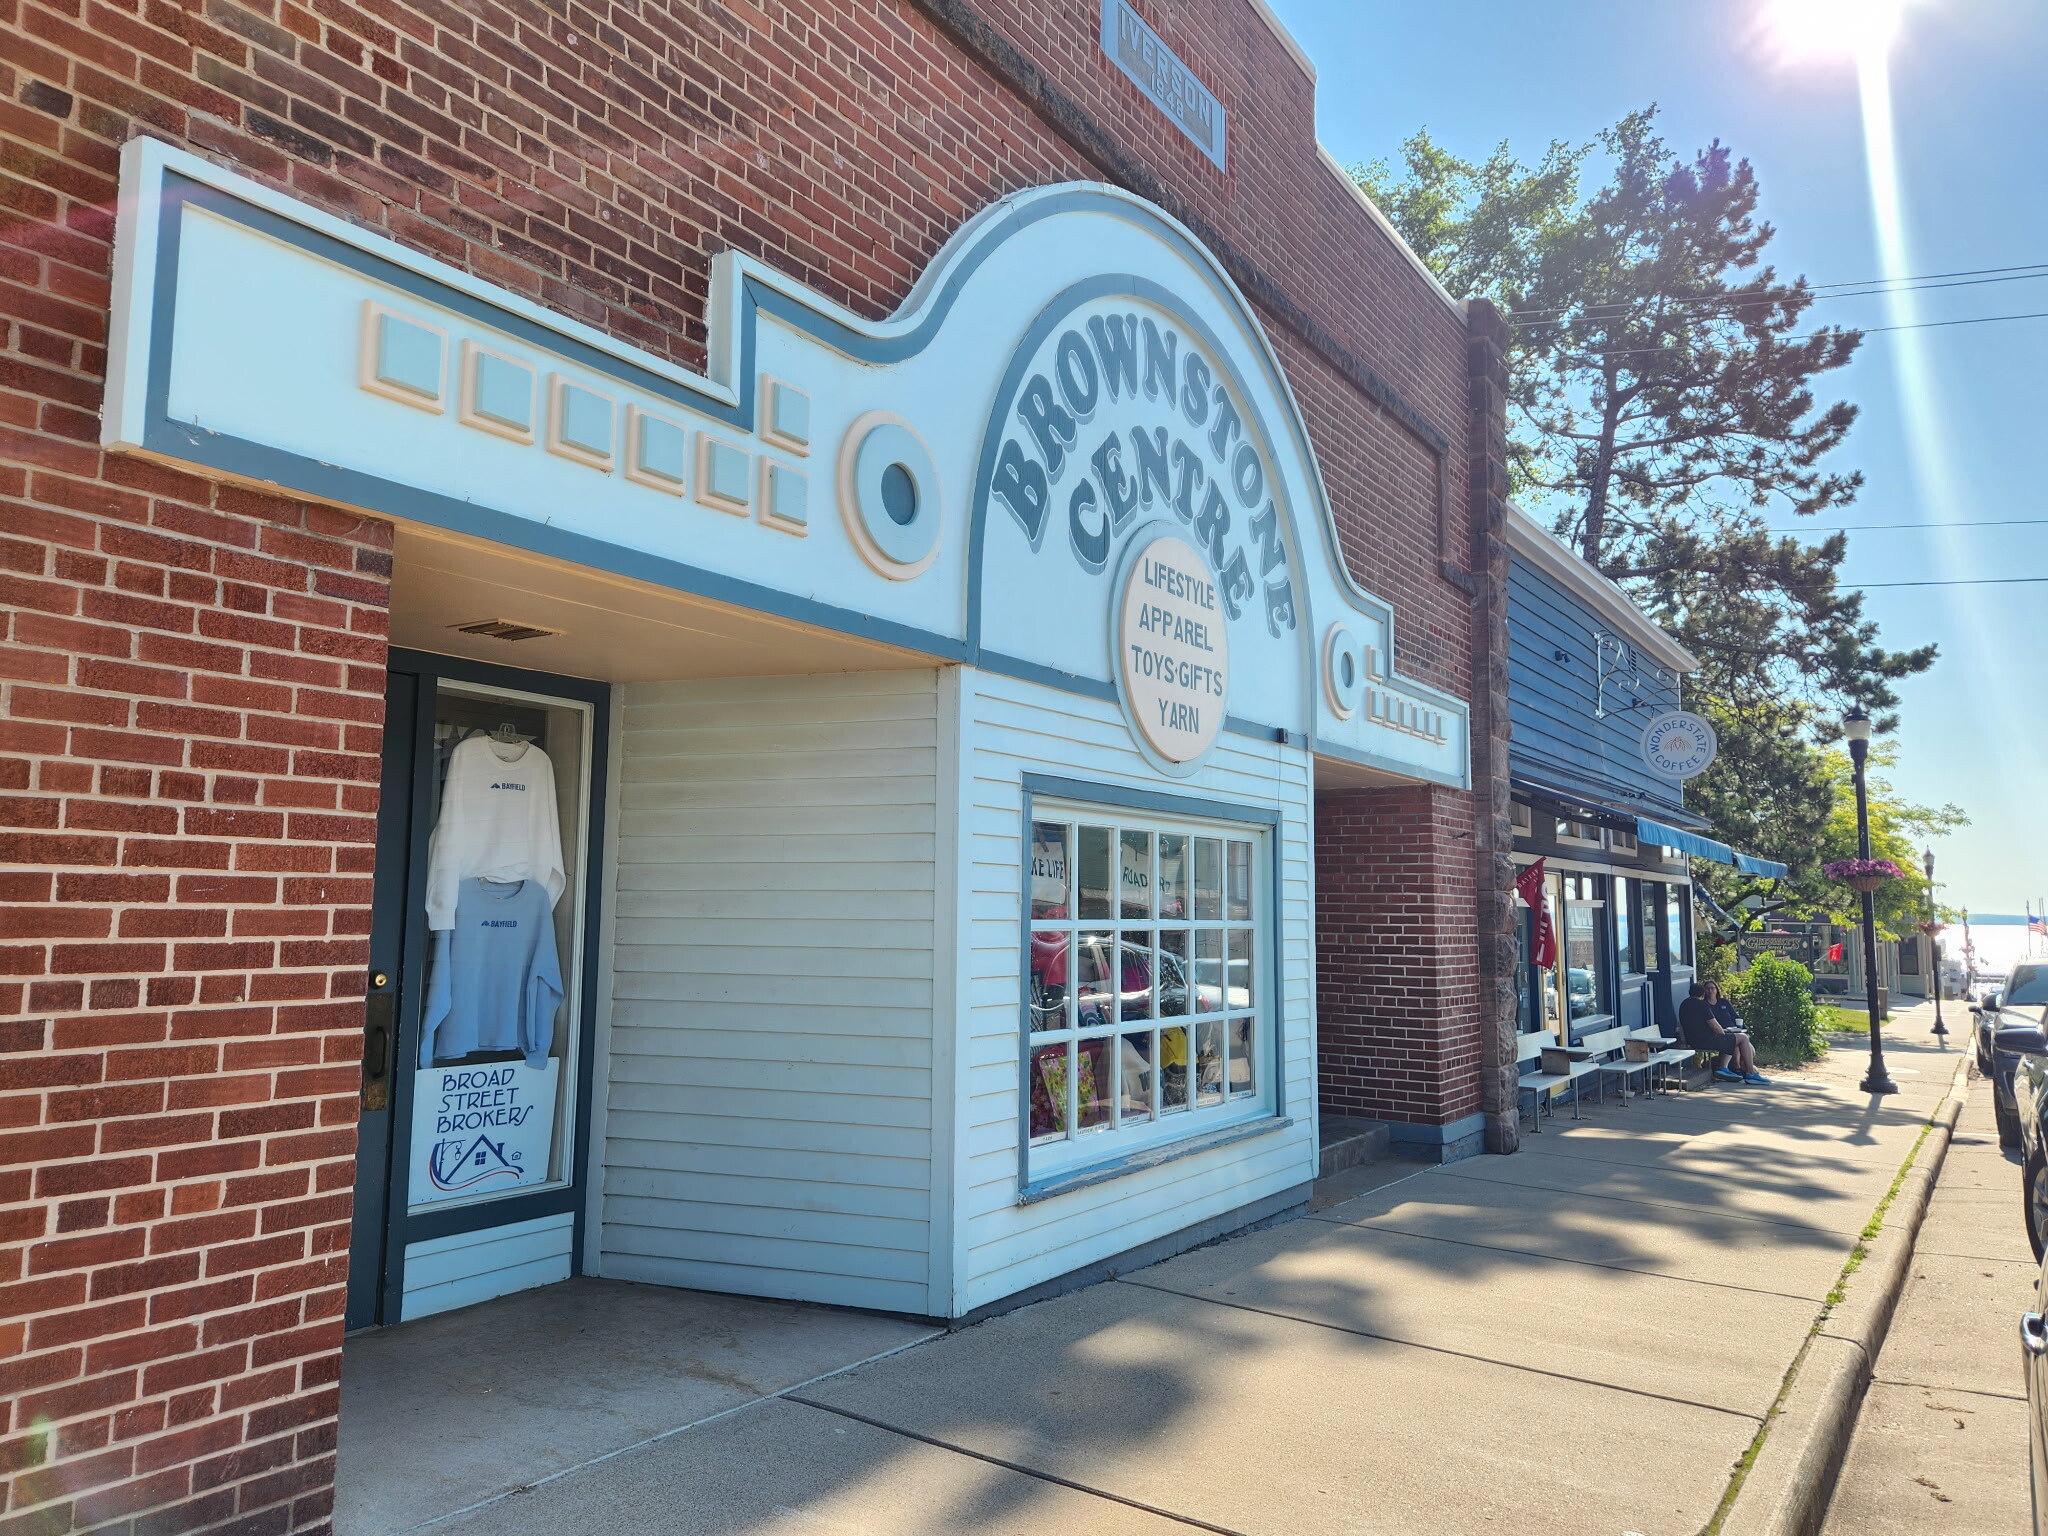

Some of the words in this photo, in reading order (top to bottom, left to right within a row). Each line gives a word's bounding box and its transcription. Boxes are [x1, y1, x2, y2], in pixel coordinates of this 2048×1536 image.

[1120, 8, 1210, 128] IVERSON
[1150, 71, 1184, 121] 1948
[991, 312, 1297, 640] BROWNSTONE
[1068, 424, 1255, 622] CENTRE
[1144, 557, 1215, 611] LIFESTYLE
[1138, 602, 1214, 653] APPAREL
[1157, 697, 1200, 734] YARN
[1650, 720, 1706, 754] WONDERSTATE
[1655, 754, 1700, 771] COFFEE
[501, 782, 526, 792] BAYFIELD
[1048, 859, 1064, 879] LIFE
[1122, 866, 1148, 888] ROAD
[490, 920, 518, 928] BAYFIELD
[442, 1068, 515, 1092] BROAD
[438, 1087, 519, 1114] STREET
[436, 1105, 534, 1134] BROKERS
